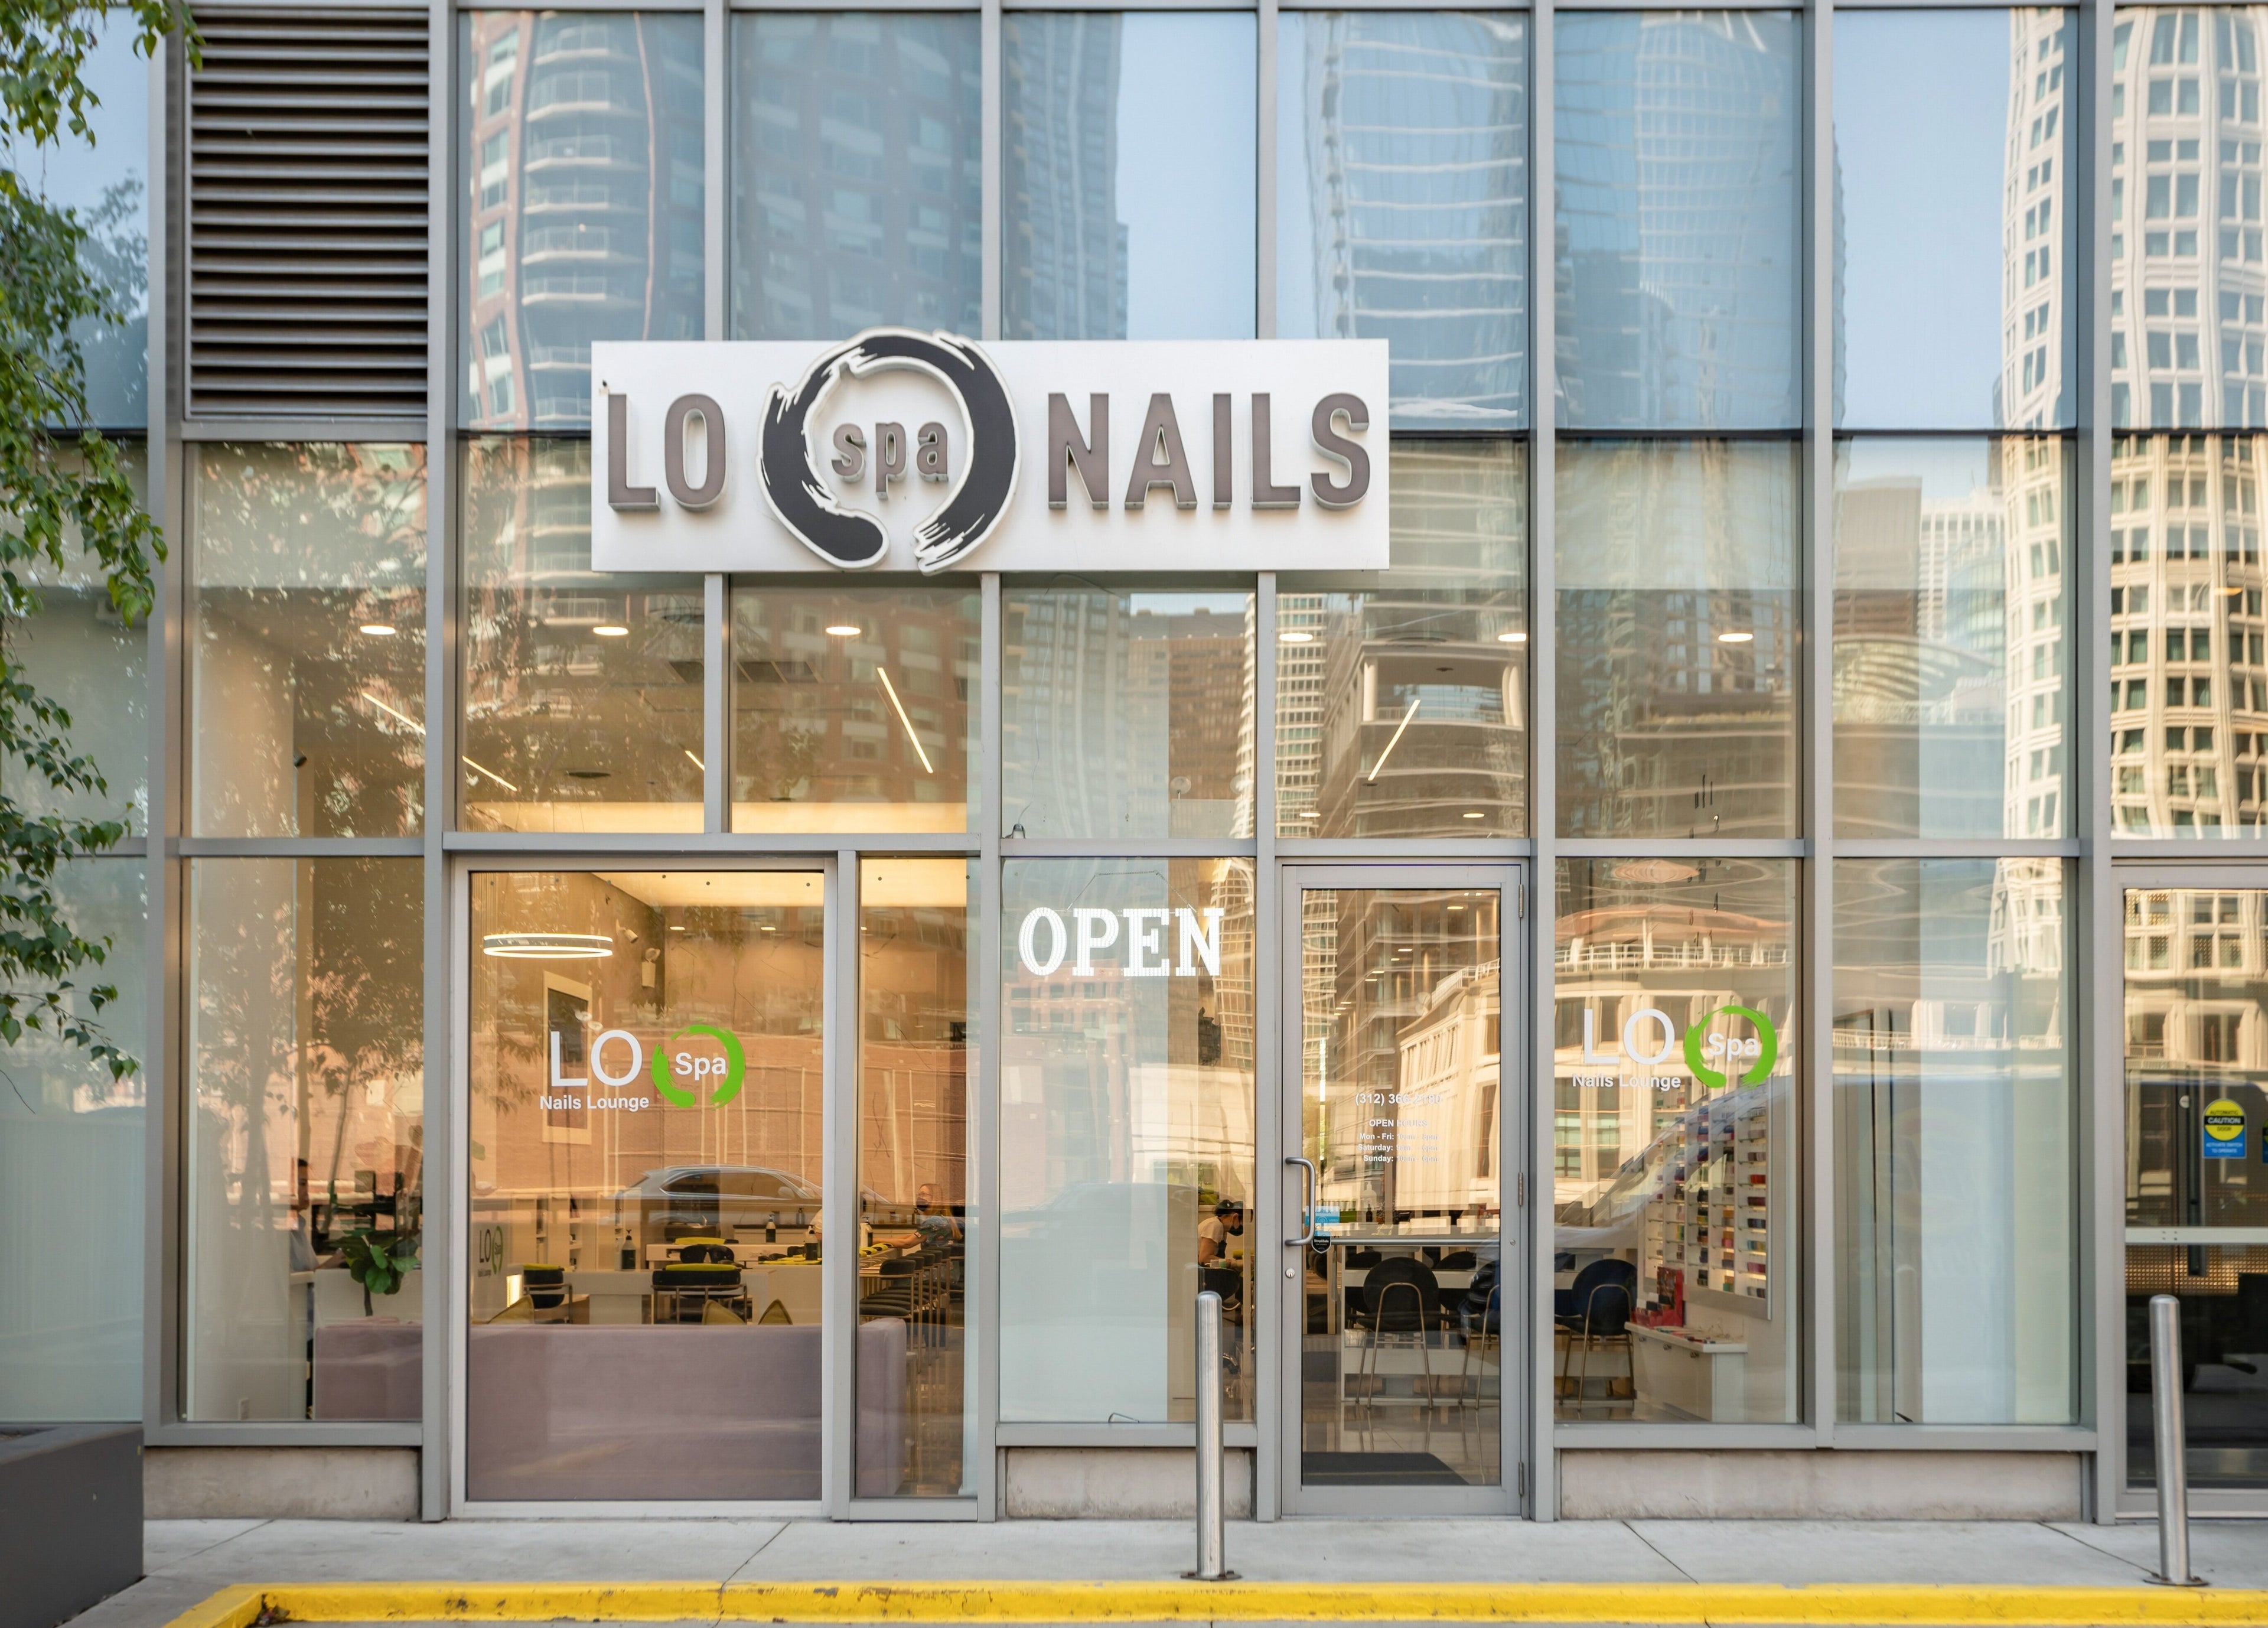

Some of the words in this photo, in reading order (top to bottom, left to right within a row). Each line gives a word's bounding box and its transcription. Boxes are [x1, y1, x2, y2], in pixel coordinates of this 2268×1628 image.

[608, 393, 726, 512] LO
[830, 421, 949, 500] spa
[1048, 392, 1370, 510] NAILS
[1018, 907, 1224, 977] OPEN
[1584, 1008, 1675, 1065] LO
[1707, 1033, 1759, 1062] Spa
[550, 1029, 643, 1086] LO
[675, 1052, 726, 1080] Spa
[1572, 1073, 1614, 1087] Nails
[1619, 1074, 1681, 1092] Lounge
[540, 1095, 581, 1109] Nails
[587, 1095, 649, 1112] Lounge
[1355, 1093, 1385, 1106] (312)
[1357, 1144, 1393, 1152] Saturday:
[1363, 1155, 1394, 1163] Sunday:
